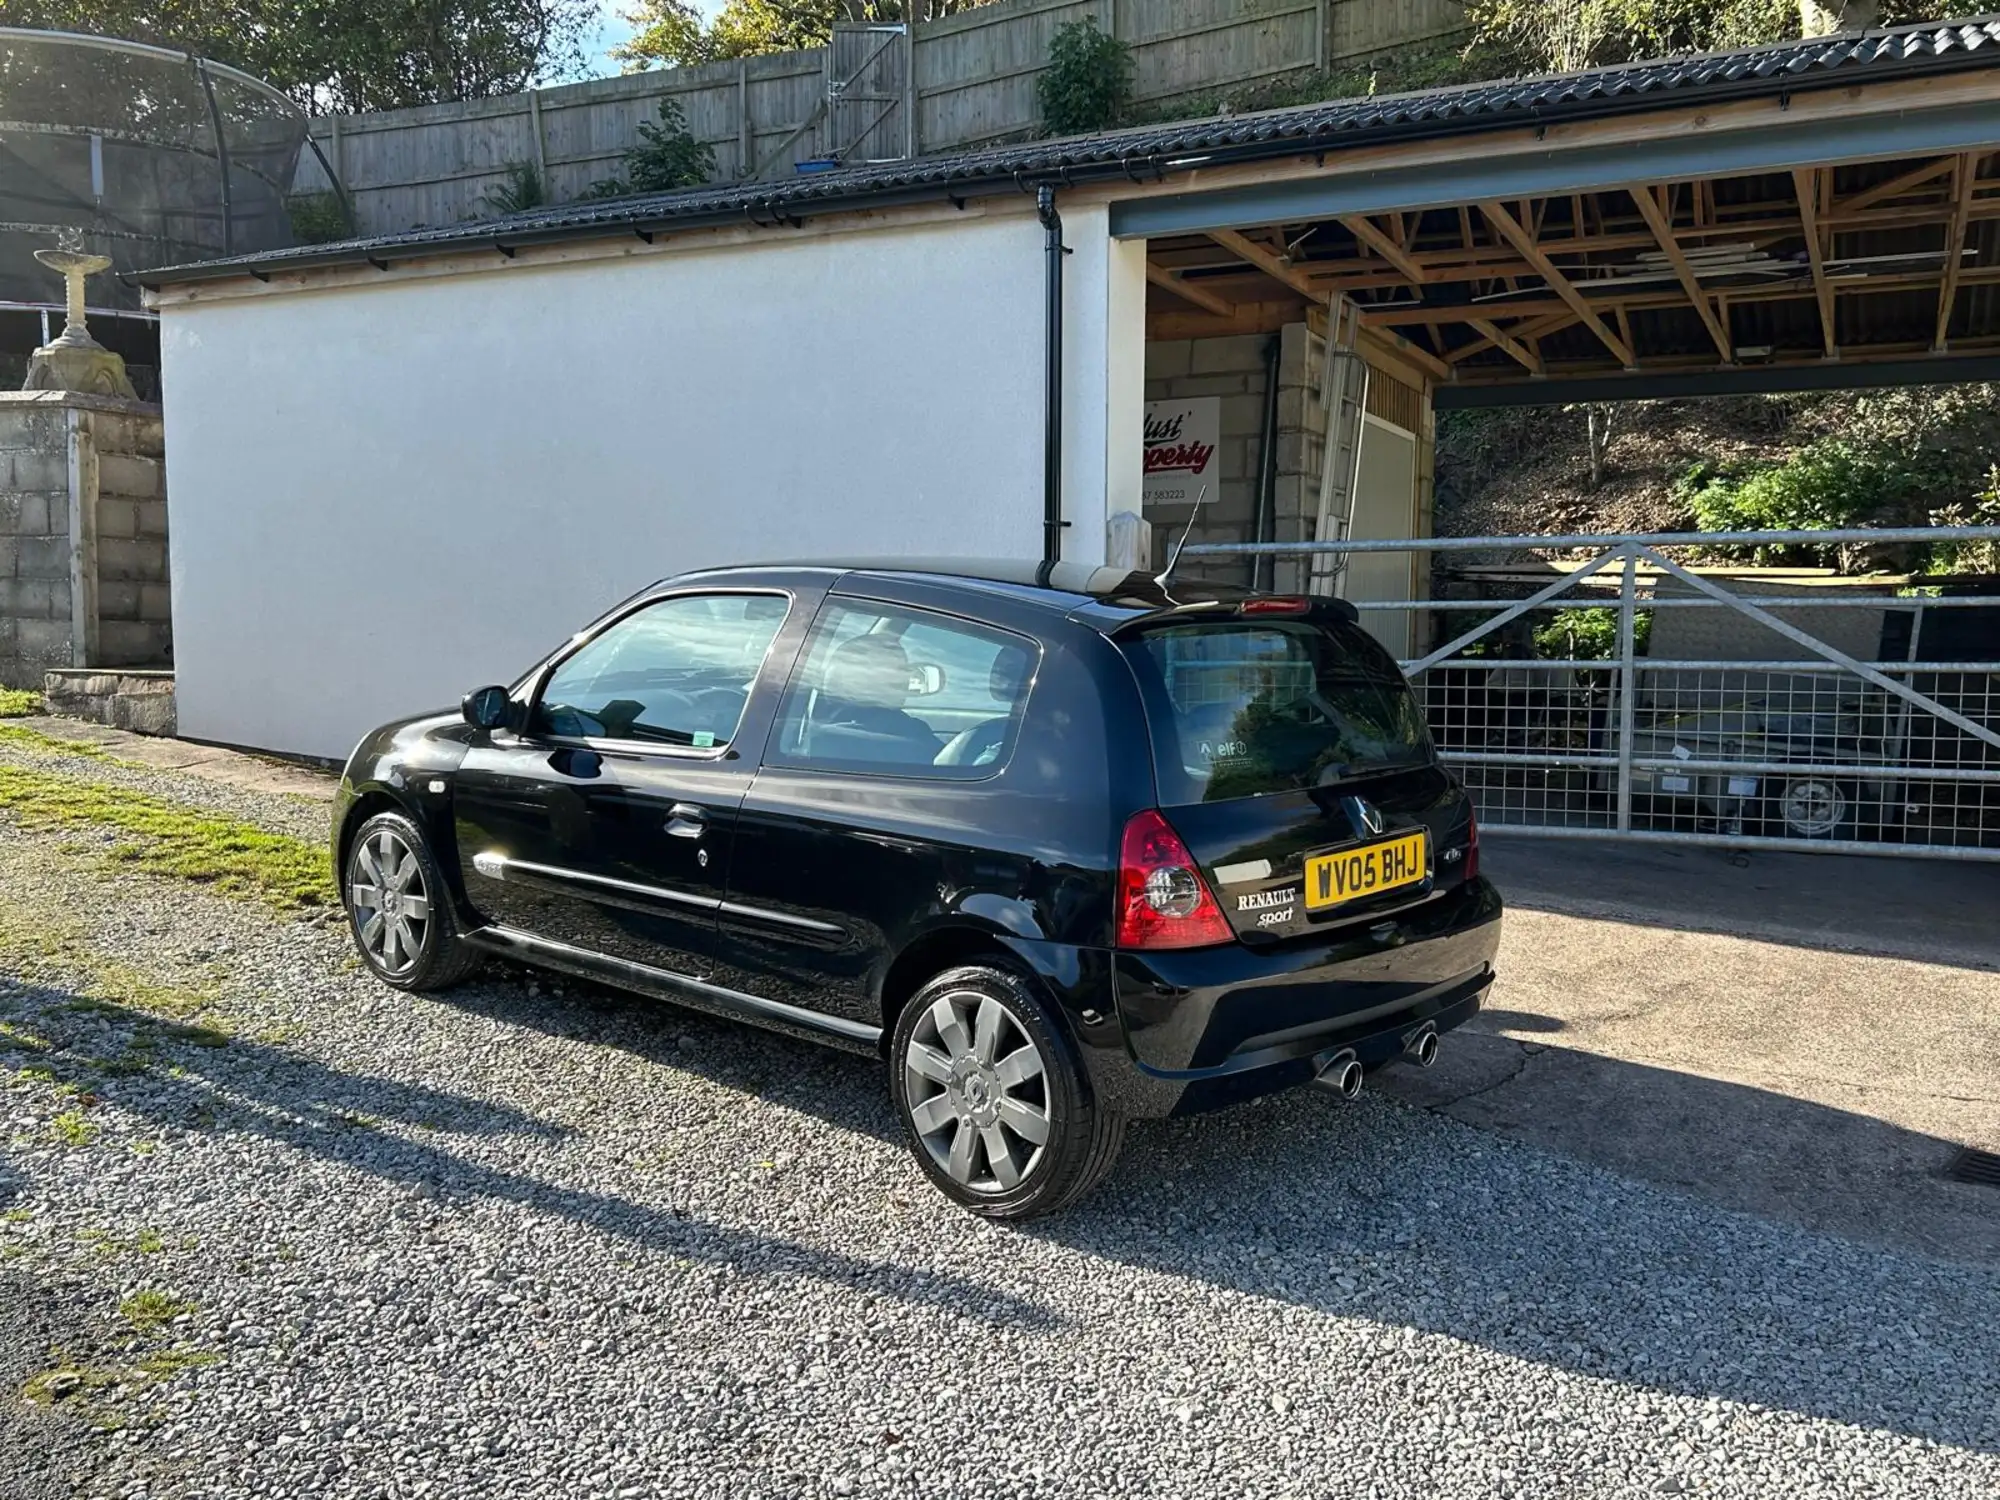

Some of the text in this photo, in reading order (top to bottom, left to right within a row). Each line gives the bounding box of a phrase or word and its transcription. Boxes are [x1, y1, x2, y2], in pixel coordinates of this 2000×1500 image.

[1218, 742, 1235, 756] elf
[1318, 841, 1417, 899] WV05 BHJ
[1237, 887, 1296, 911] RENAULT
[1257, 906, 1293, 928] sport
